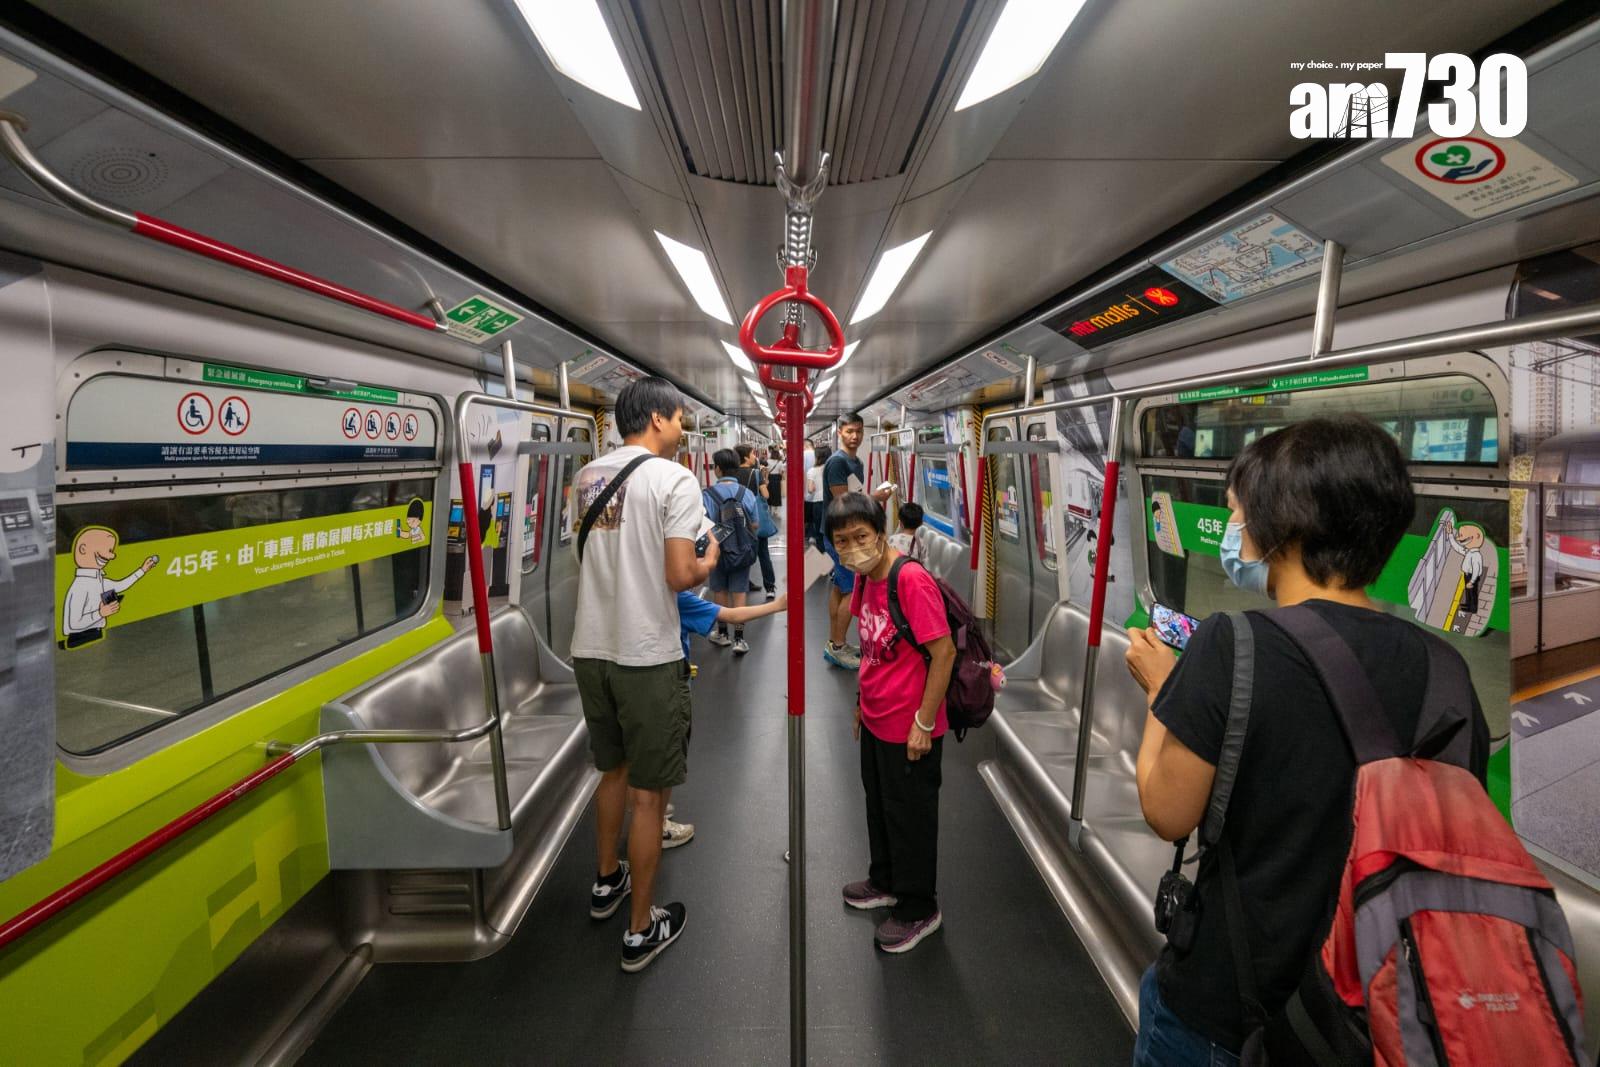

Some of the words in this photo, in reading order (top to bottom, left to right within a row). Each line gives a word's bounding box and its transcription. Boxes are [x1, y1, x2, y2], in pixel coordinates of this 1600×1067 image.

[1197, 517, 1223, 536] 45年
[254, 566, 269, 575] Your
[271, 560, 295, 571] Journey
[295, 556, 314, 566] Starts
